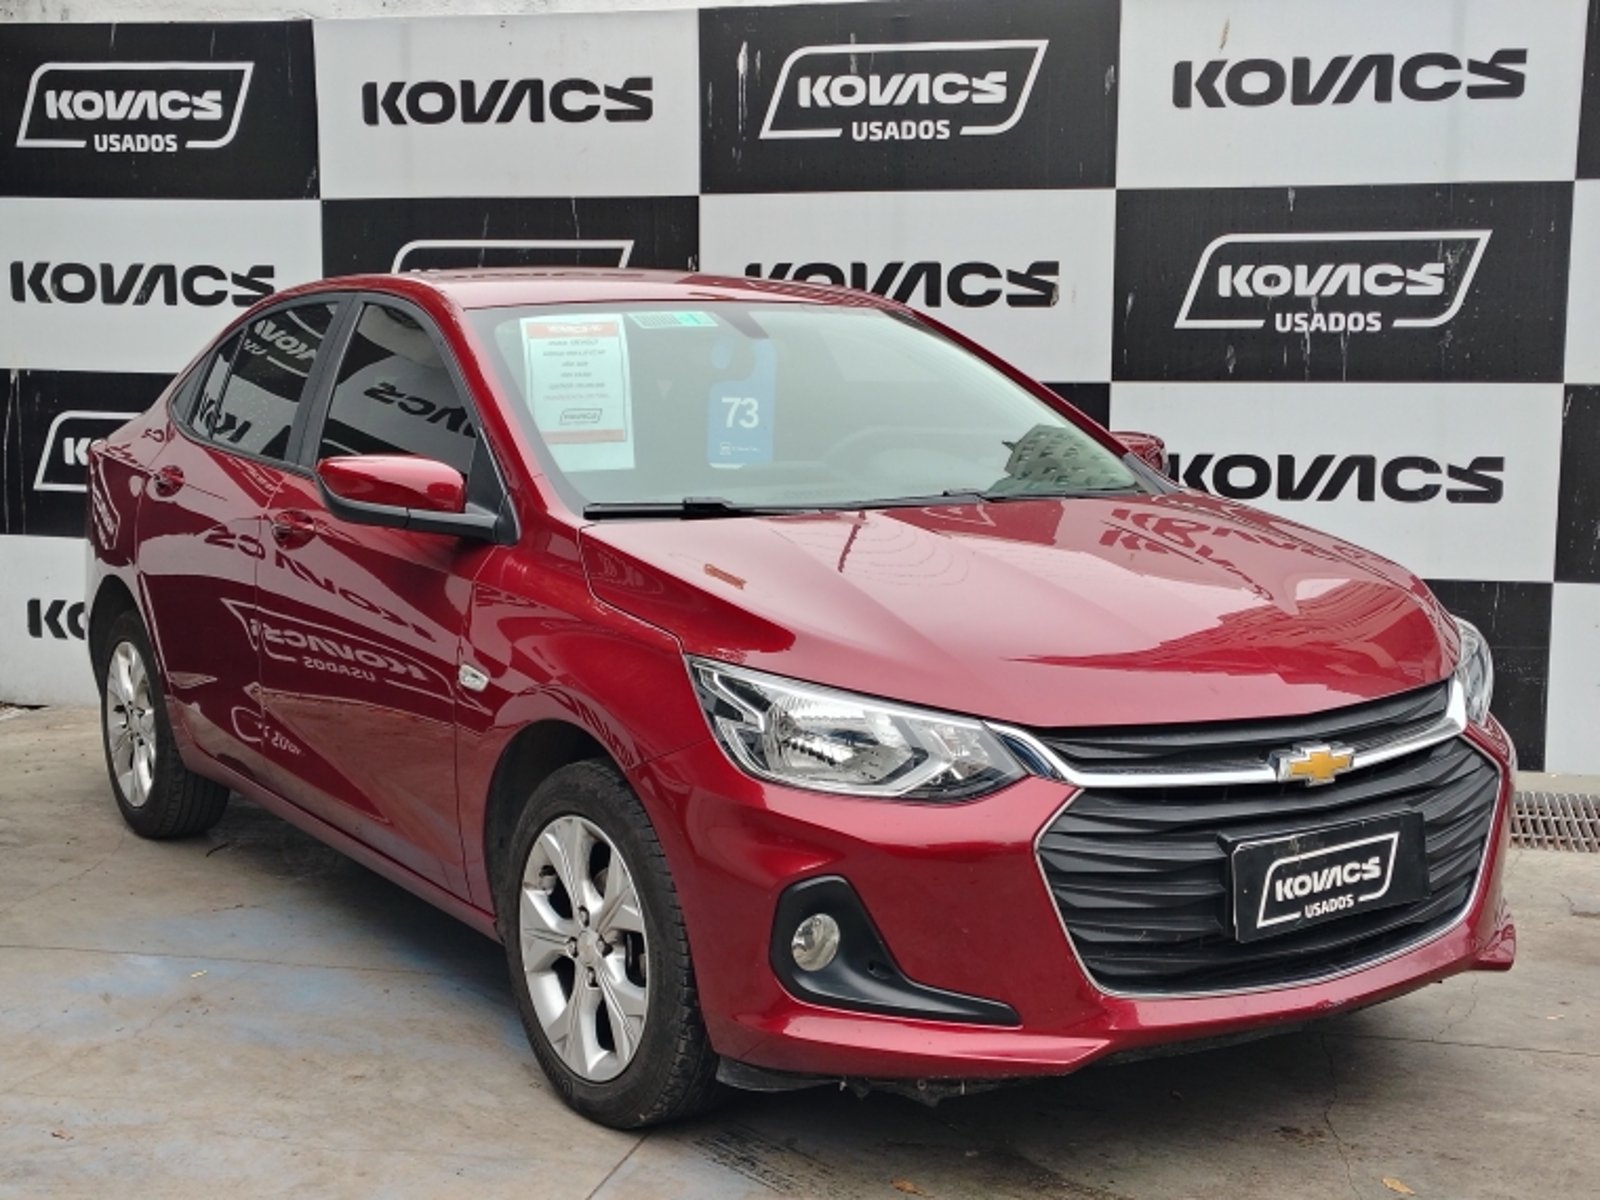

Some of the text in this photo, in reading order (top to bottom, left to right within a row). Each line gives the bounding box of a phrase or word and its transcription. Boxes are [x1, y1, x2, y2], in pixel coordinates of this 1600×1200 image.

[799, 72, 1007, 108] KOVACS
[1173, 49, 1527, 108] KOVACS
[46, 91, 222, 120] KOVACS
[362, 77, 653, 125] KOVACS
[94, 134, 178, 153] USADOS
[852, 120, 951, 141] USADOS
[10, 261, 275, 307] KOVACS
[1219, 263, 1445, 297] KOVACS
[1276, 312, 1382, 332] USADOS
[722, 396, 759, 429] 73
[1275, 856, 1382, 902] KOVACS
[1305, 894, 1355, 918] USADOS
